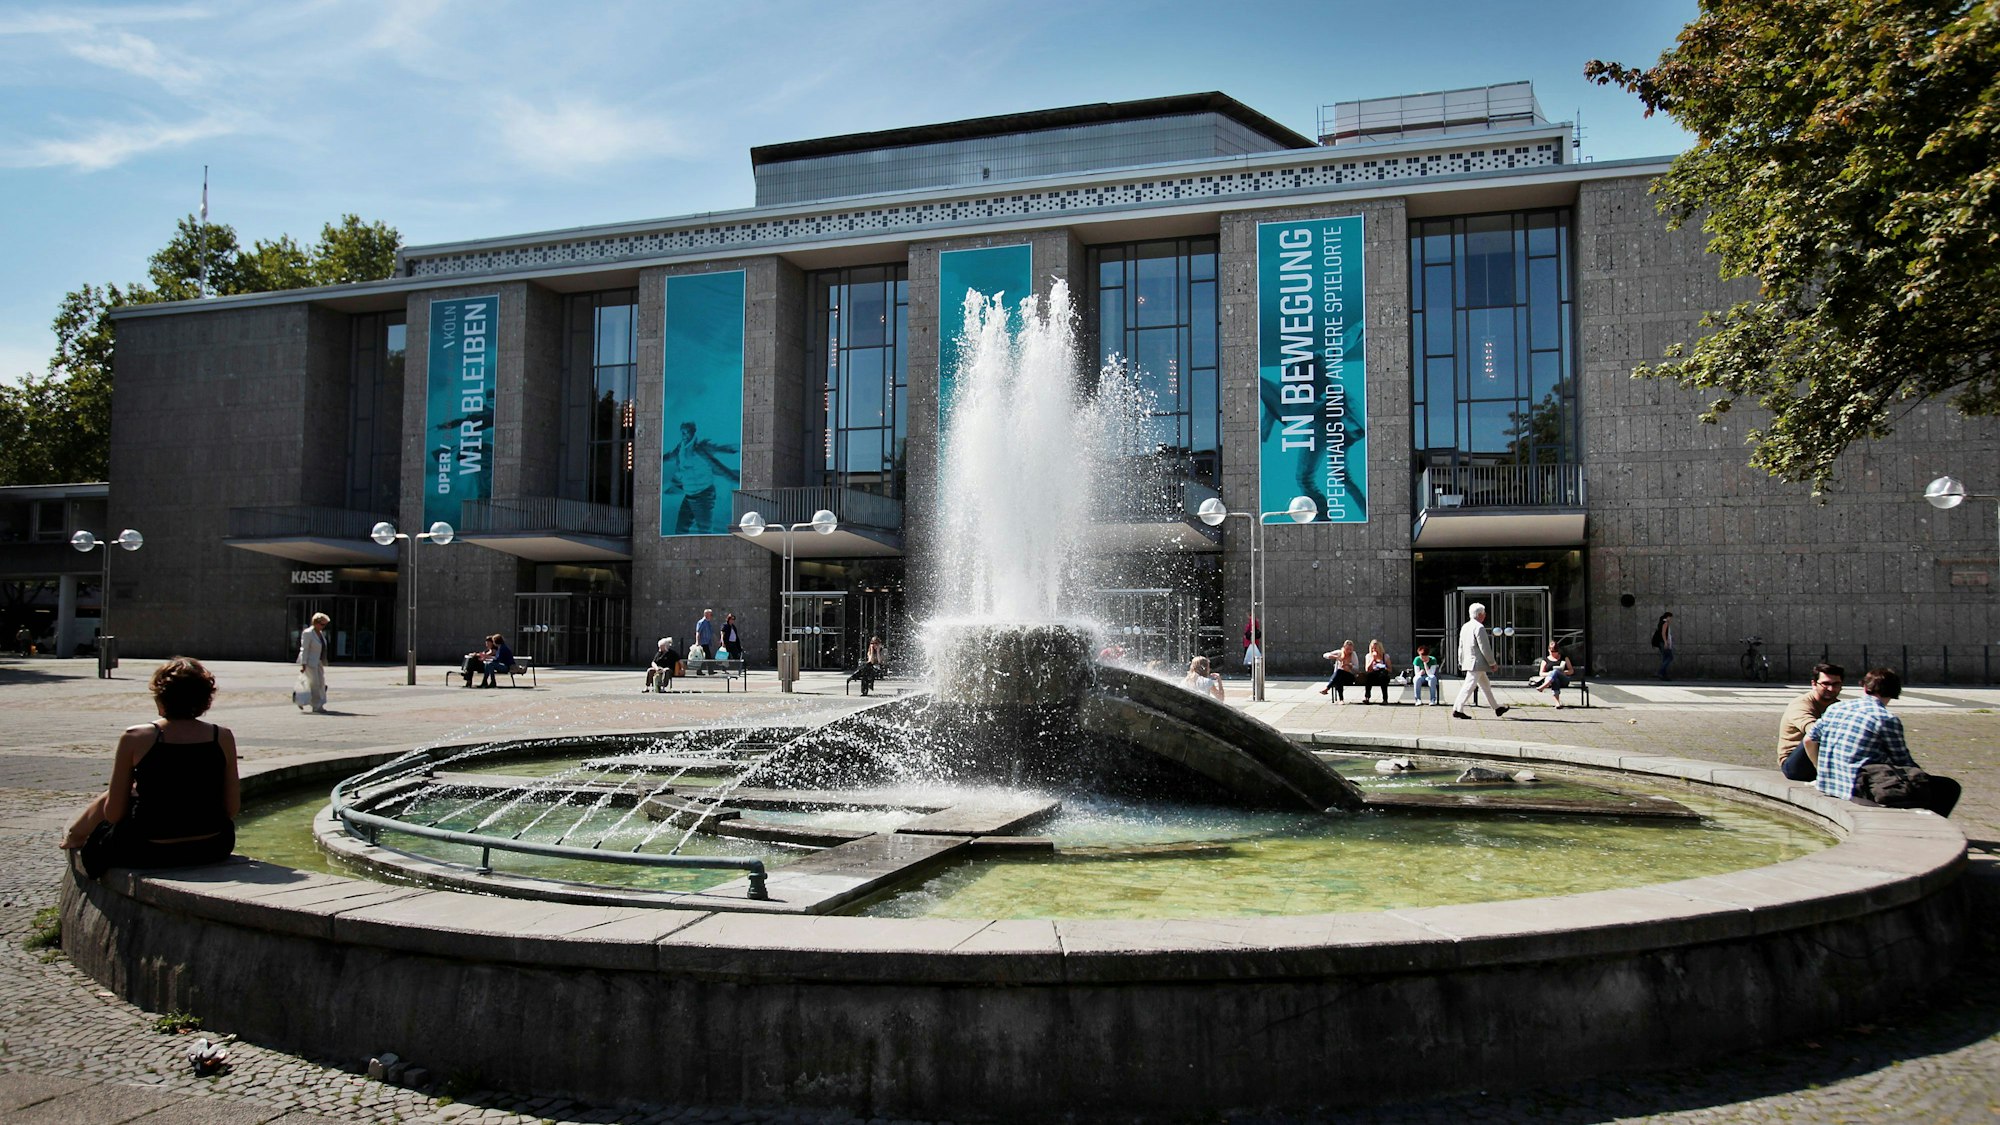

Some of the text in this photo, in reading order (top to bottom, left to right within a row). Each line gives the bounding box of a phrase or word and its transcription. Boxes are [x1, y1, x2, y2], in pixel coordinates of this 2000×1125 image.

[459, 303, 487, 475] WIR BLEIBEN
[1279, 228, 1315, 452] IN BEWEGUNG
[1323, 225, 1345, 520] OPERNHAUS UND ANDERE SPIELORTE
[291, 570, 333, 583] KASSE
